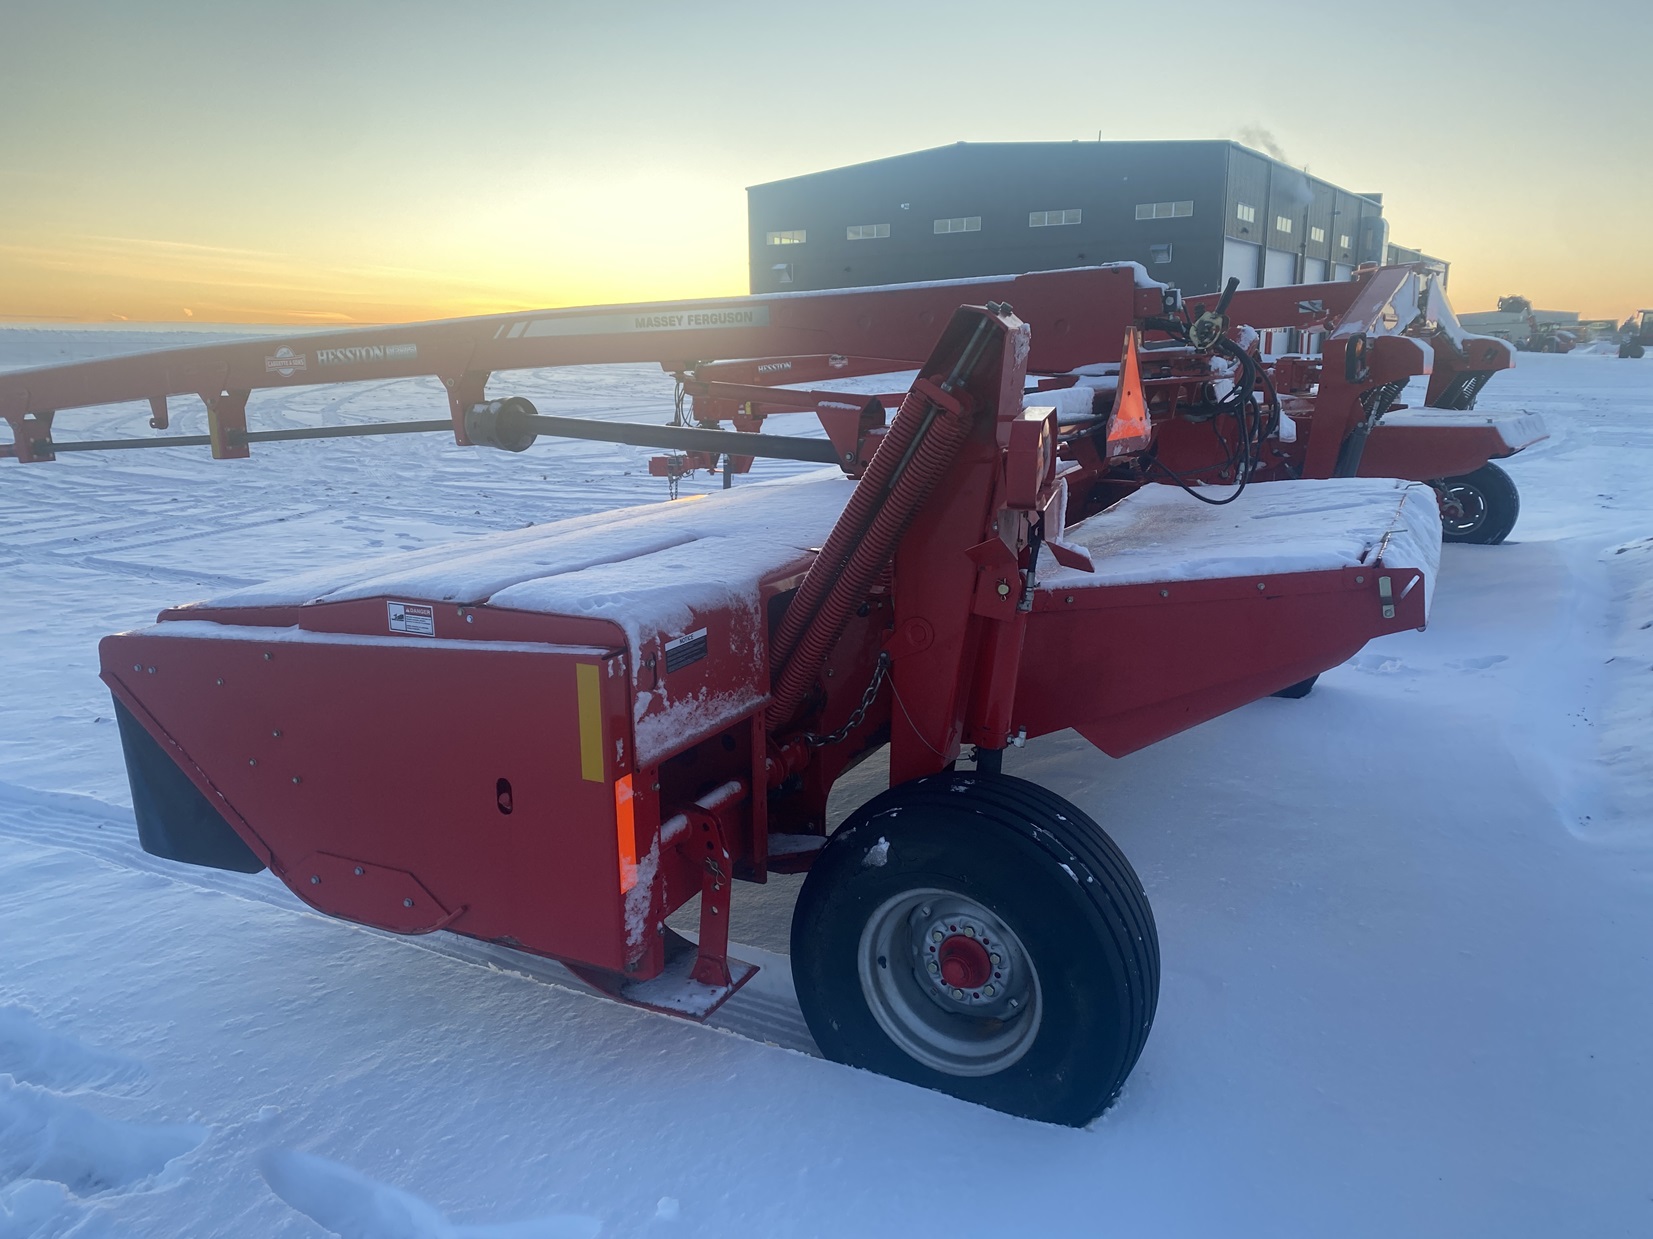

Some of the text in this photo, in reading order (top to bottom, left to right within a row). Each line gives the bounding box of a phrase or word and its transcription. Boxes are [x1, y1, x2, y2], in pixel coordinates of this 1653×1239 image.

[635, 311, 753, 328] MASSEY FERGUSON
[316, 345, 384, 365] HESSTON
[758, 361, 792, 373] HESSTON
[679, 634, 694, 643] NOTICE
